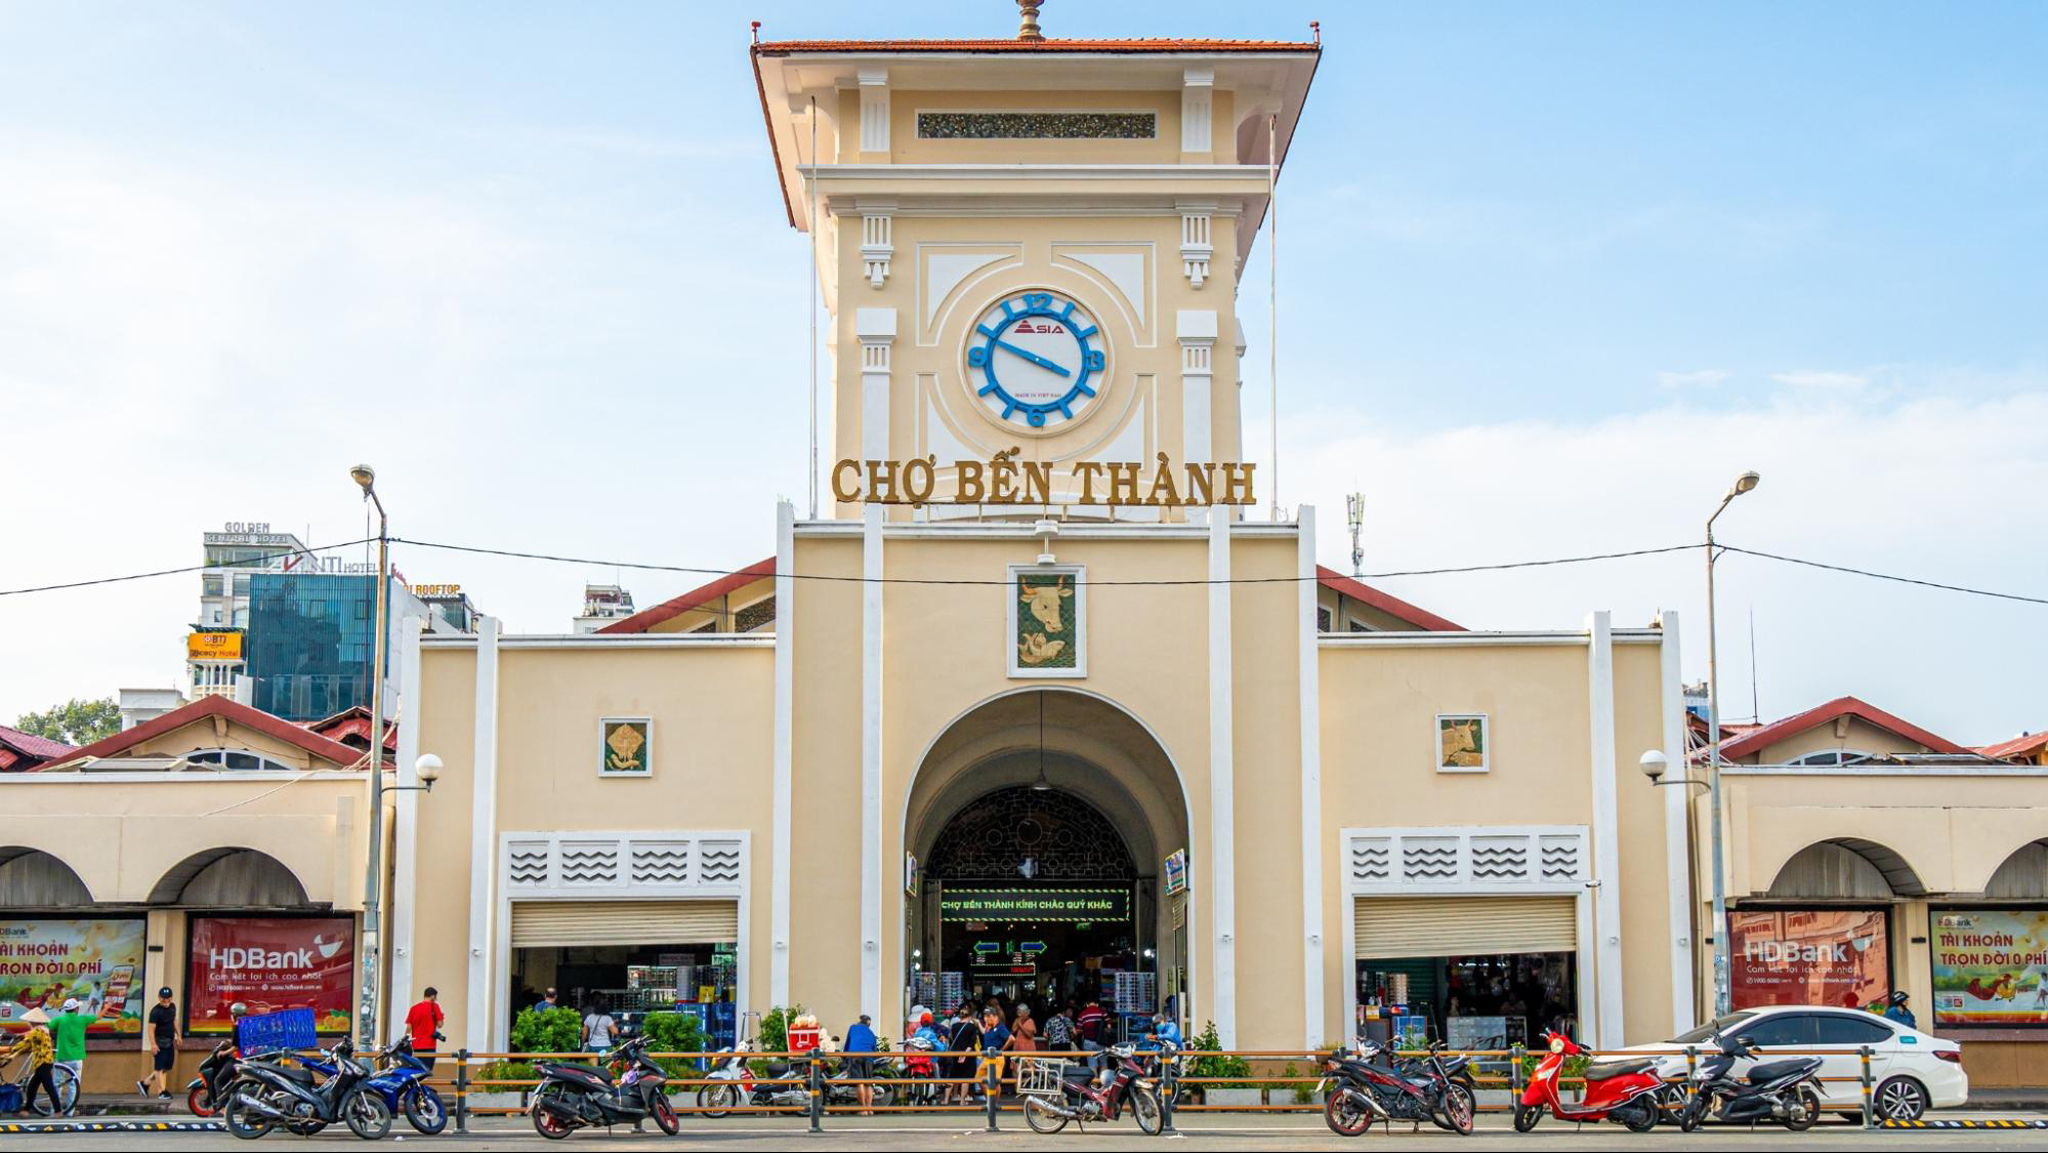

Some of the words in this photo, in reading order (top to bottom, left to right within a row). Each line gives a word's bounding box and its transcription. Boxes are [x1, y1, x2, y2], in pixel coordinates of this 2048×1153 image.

[1023, 293, 1053, 314] 12
[968, 346, 988, 369] 9
[1027, 406, 1046, 428] 6
[831, 454, 937, 508] CHỢ
[955, 446, 1054, 505] BẾN
[1072, 452, 1258, 505] THÀNH
[225, 521, 271, 533] GOLDEN
[344, 562, 378, 574] HOTEL
[416, 584, 460, 595] ROOFTOP
[984, 899, 1014, 909] THÀNH
[1016, 898, 1037, 909] KÍNH
[1039, 898, 1065, 909] CHÀO
[1066, 898, 1085, 909] QUÝ
[1087, 899, 1113, 909] KHÁC
[17, 939, 69, 956] KHOẢN
[1939, 932, 1959, 947] TÀI
[1963, 931, 2014, 947] KHOẢN
[210, 947, 314, 969] HDBank
[1745, 940, 1848, 962] HDBank
[1940, 953, 1980, 968] TRỌN
[2025, 950, 2048, 965] PHÍ
[78, 958, 103, 975] PHÍ
